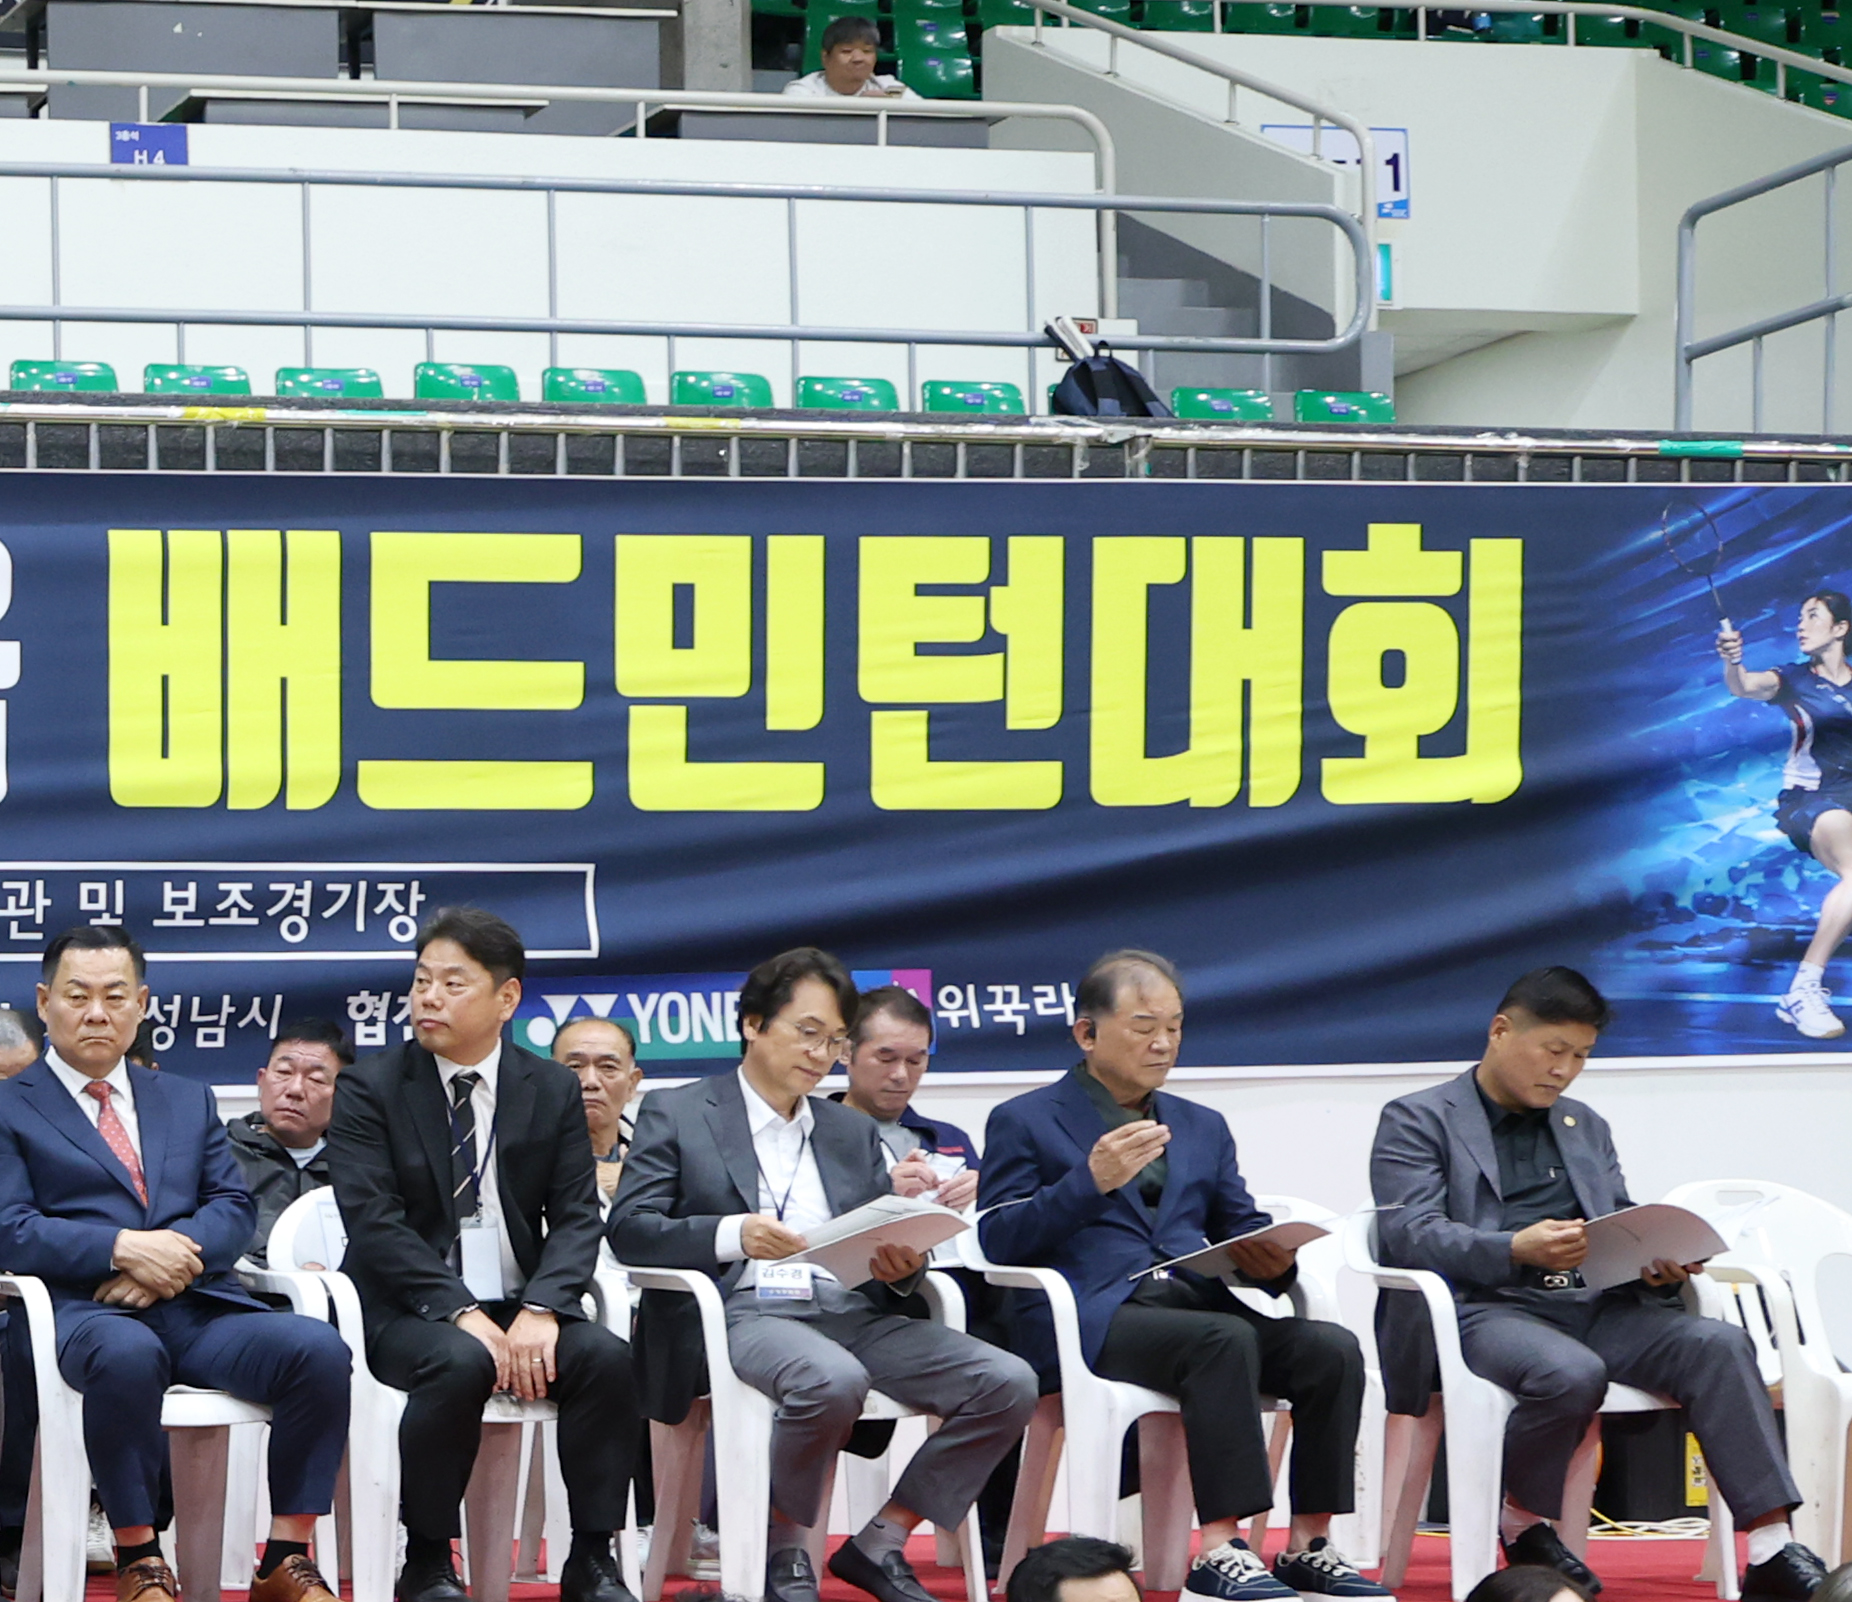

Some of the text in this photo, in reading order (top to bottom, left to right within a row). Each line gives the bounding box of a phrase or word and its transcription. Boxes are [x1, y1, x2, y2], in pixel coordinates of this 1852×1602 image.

[108, 523, 1524, 812] 배드민턴대회
[153, 878, 426, 944] 보조경기장
[146, 994, 282, 1052] 성남시
[627, 991, 741, 1047] YONE
